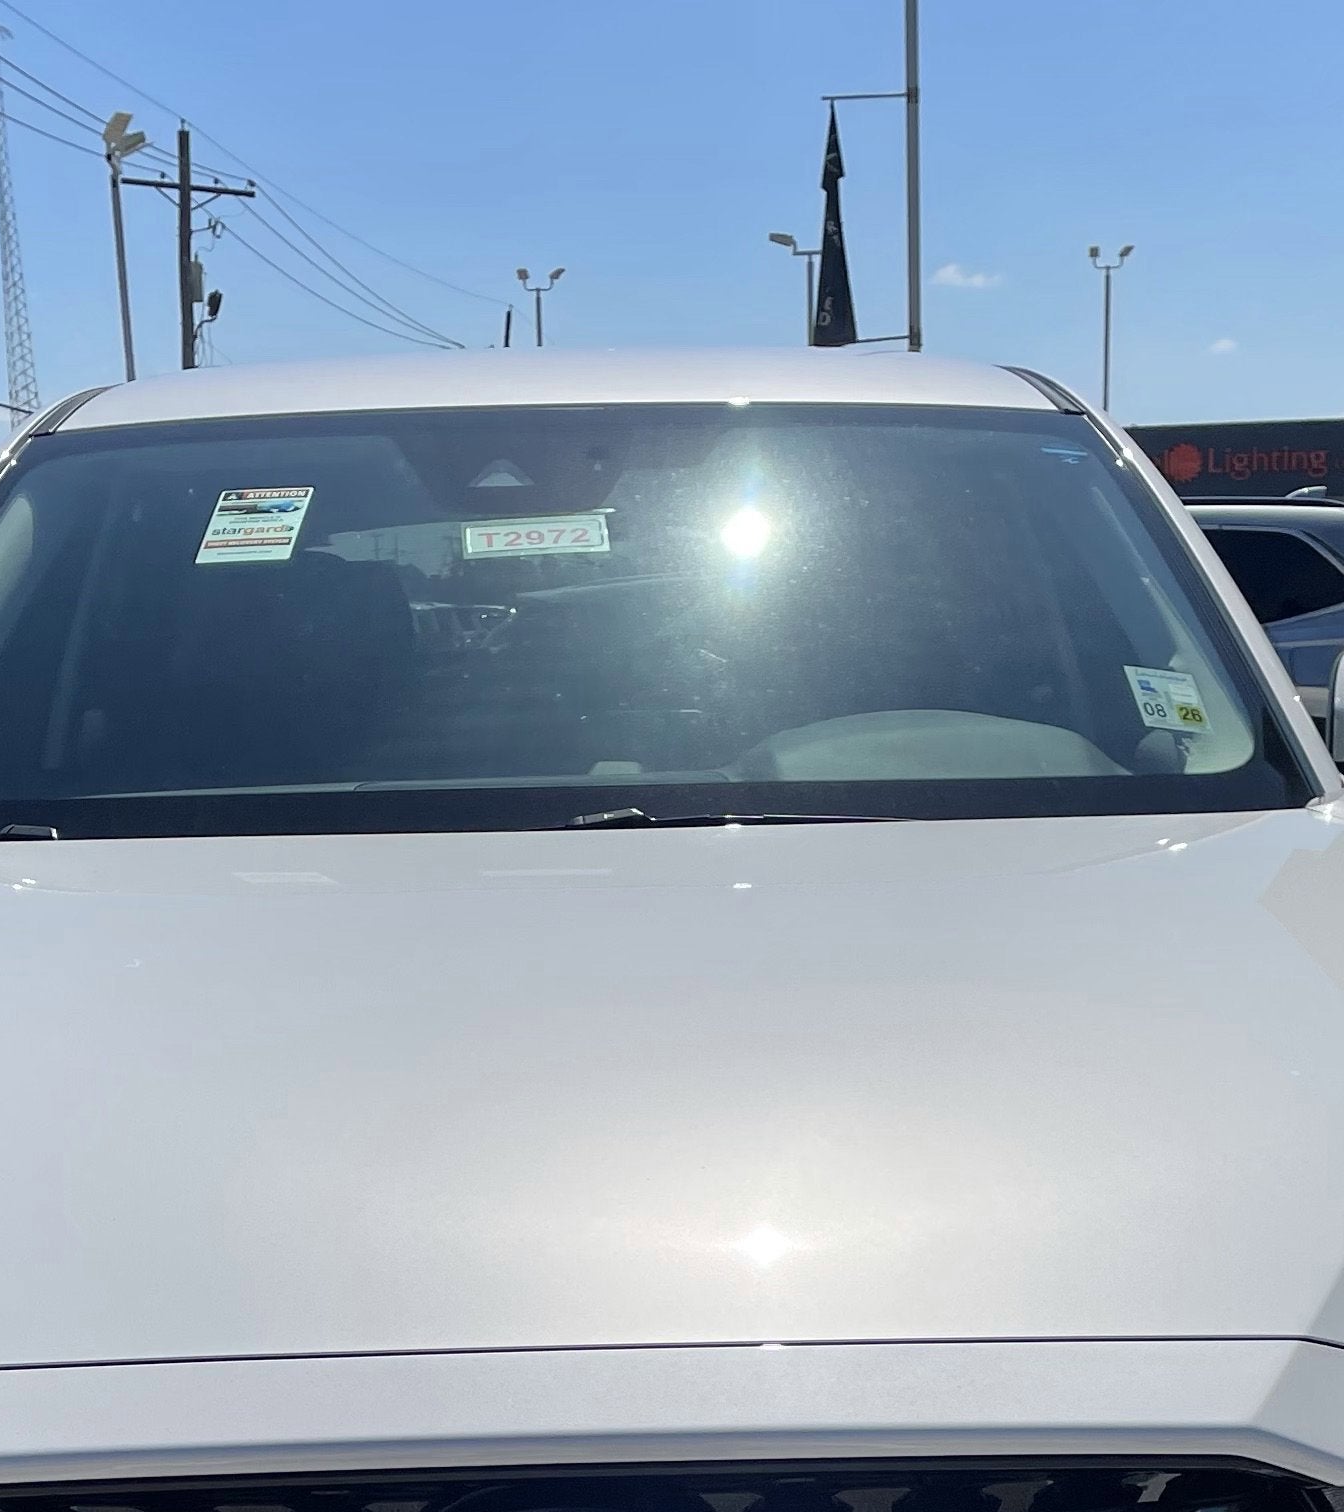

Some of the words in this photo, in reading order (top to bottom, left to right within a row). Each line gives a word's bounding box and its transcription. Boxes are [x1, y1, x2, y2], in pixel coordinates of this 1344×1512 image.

[1208, 447, 1328, 480] Lighting
[246, 489, 306, 499] ATTENTION
[477, 527, 591, 548] T2972
[1143, 702, 1167, 718] 08
